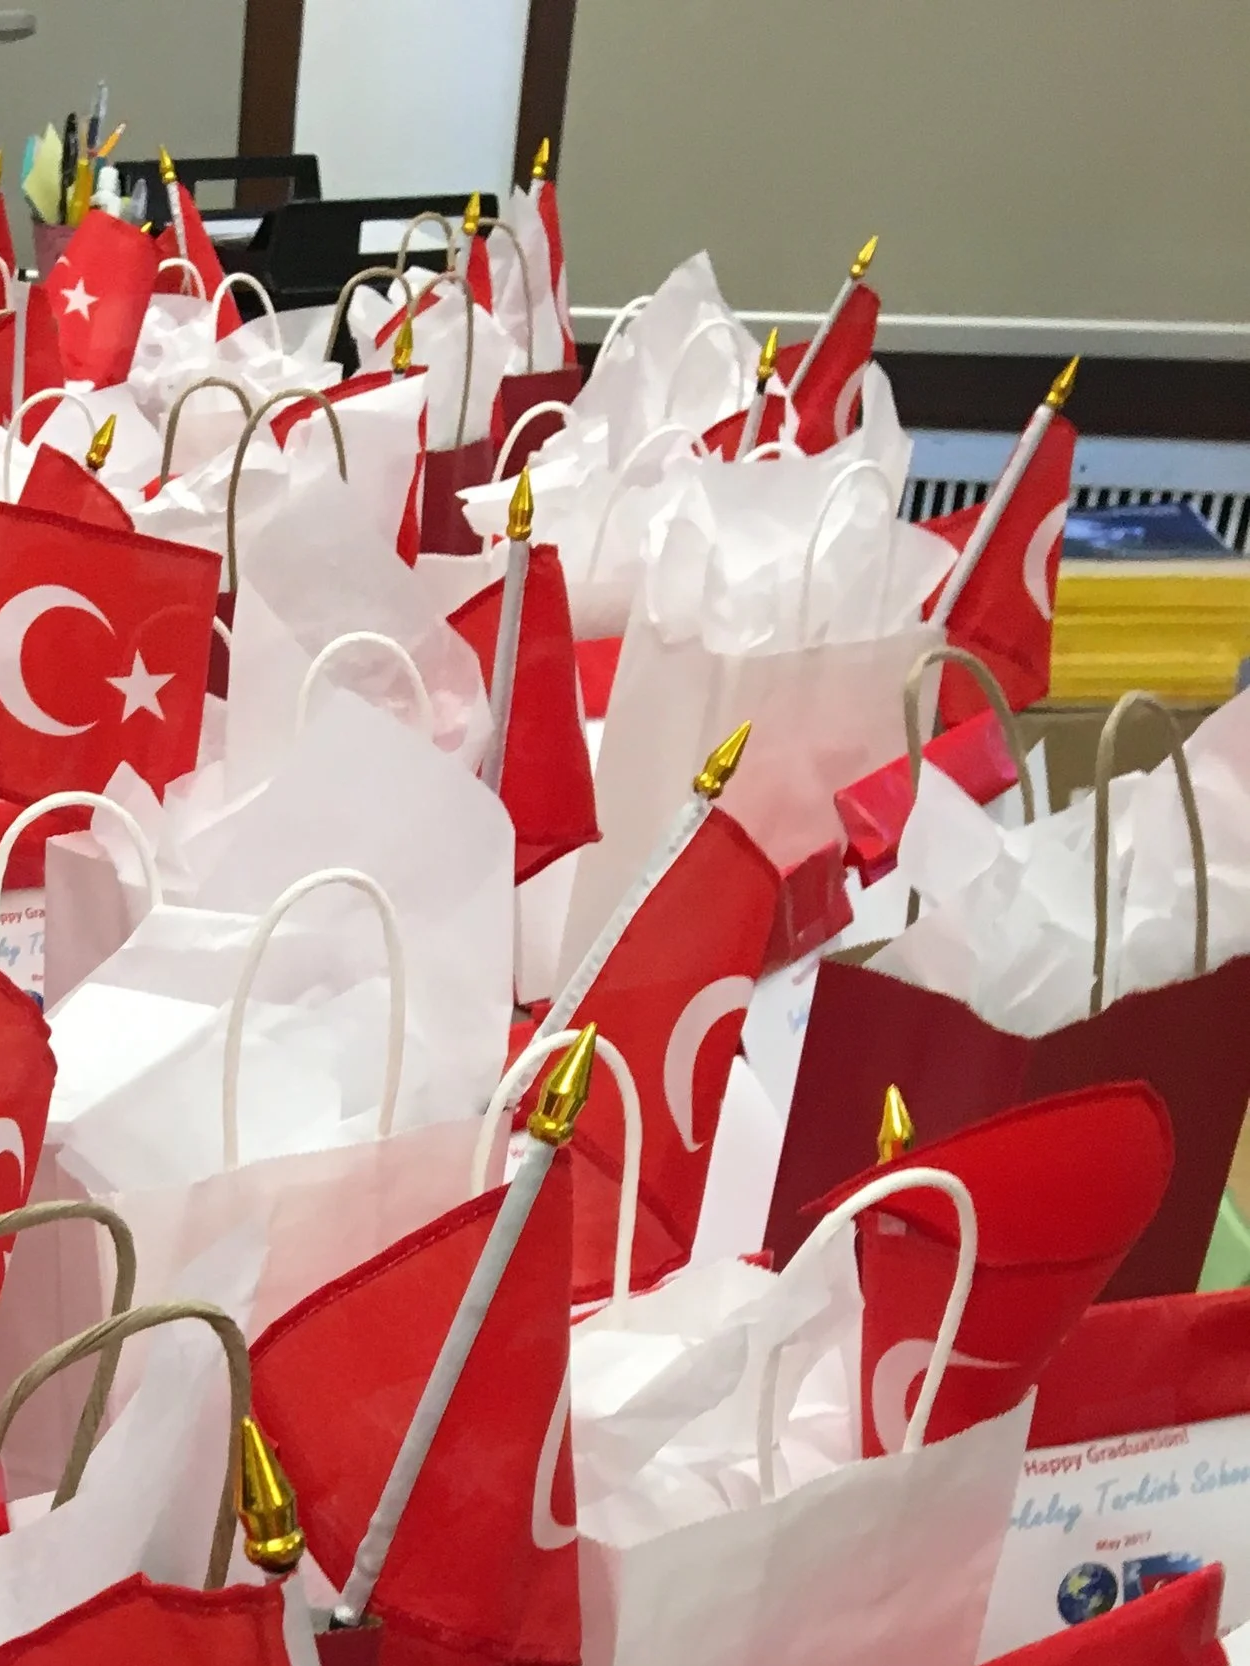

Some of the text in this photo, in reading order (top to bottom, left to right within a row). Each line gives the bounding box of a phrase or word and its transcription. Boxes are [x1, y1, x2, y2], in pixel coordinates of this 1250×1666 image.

[1023, 1427, 1190, 1477] Happy Graduation!
[1010, 1457, 1250, 1534] rkeley Turkish Schoo
